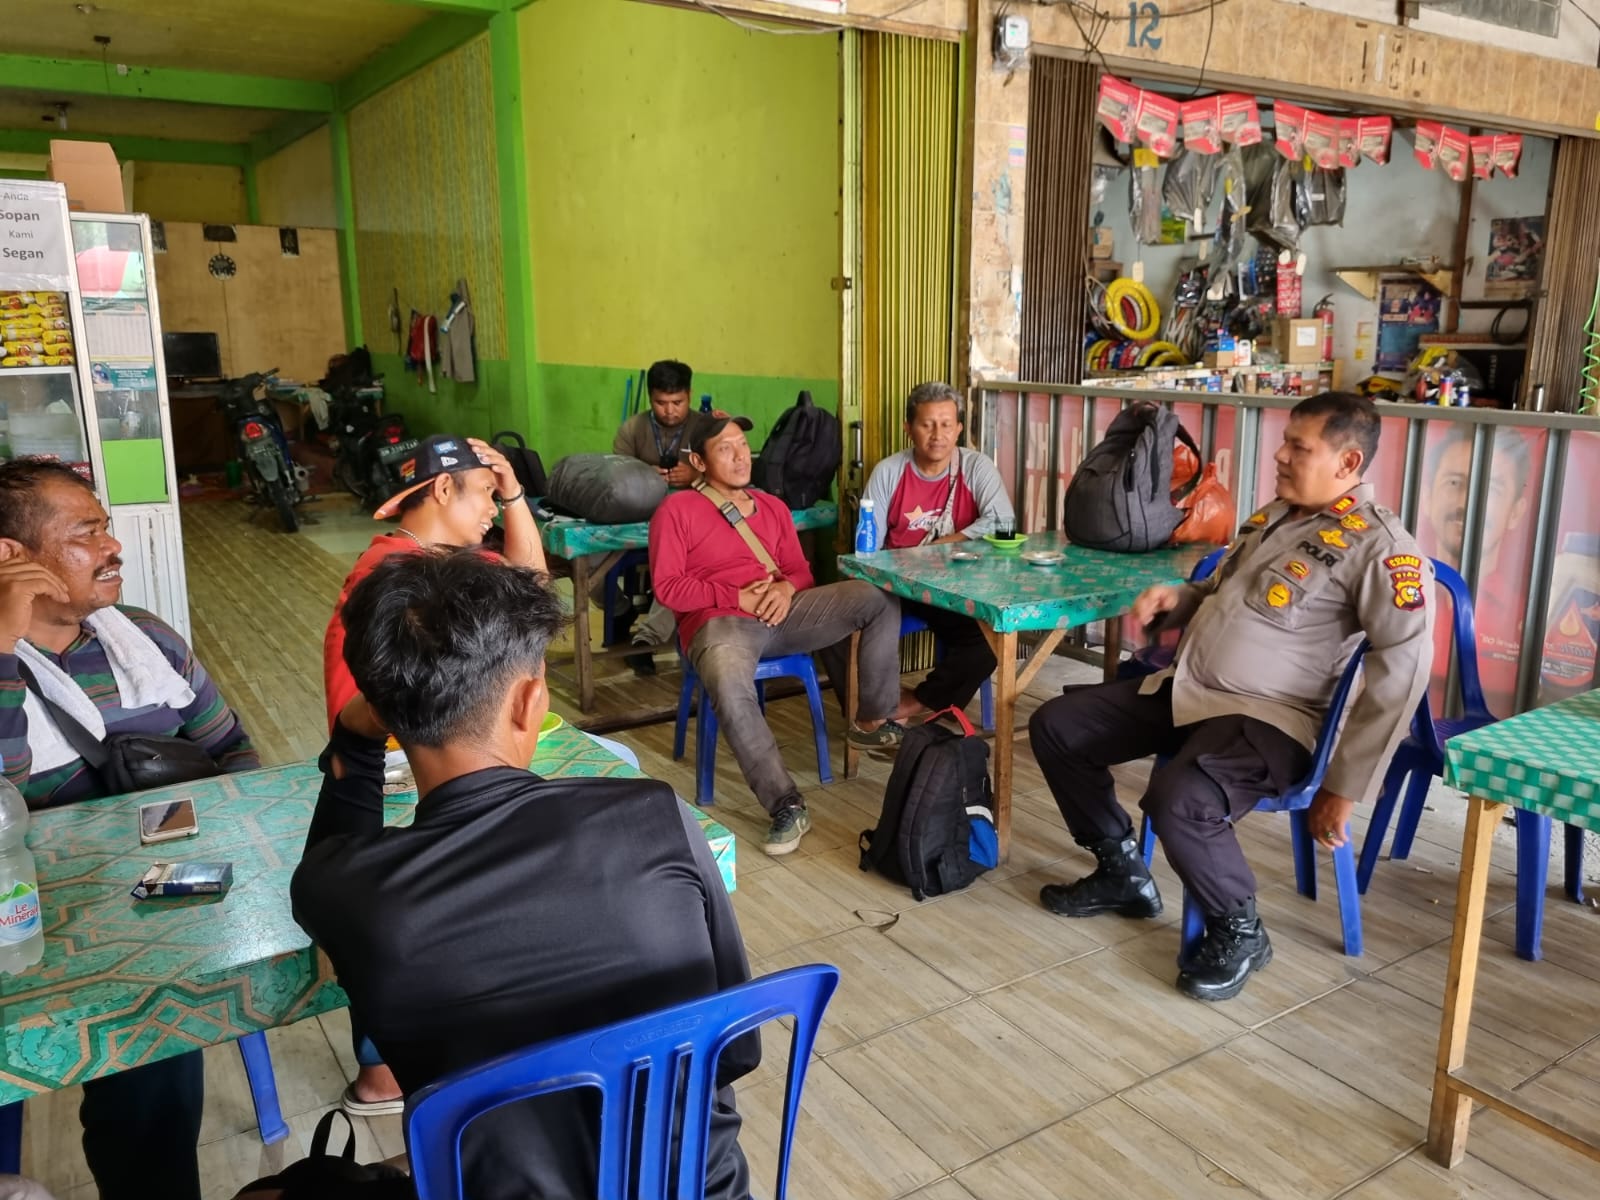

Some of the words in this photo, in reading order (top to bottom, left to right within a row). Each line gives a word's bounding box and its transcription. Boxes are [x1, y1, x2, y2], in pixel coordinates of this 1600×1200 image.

[1126, 2, 1162, 50] 12
[8, 230, 34, 239] Kami
[2, 247, 44, 260] Segan
[1297, 541, 1337, 567] POLRI
[1394, 571, 1419, 579] RIAU
[15, 904, 27, 914] Le
